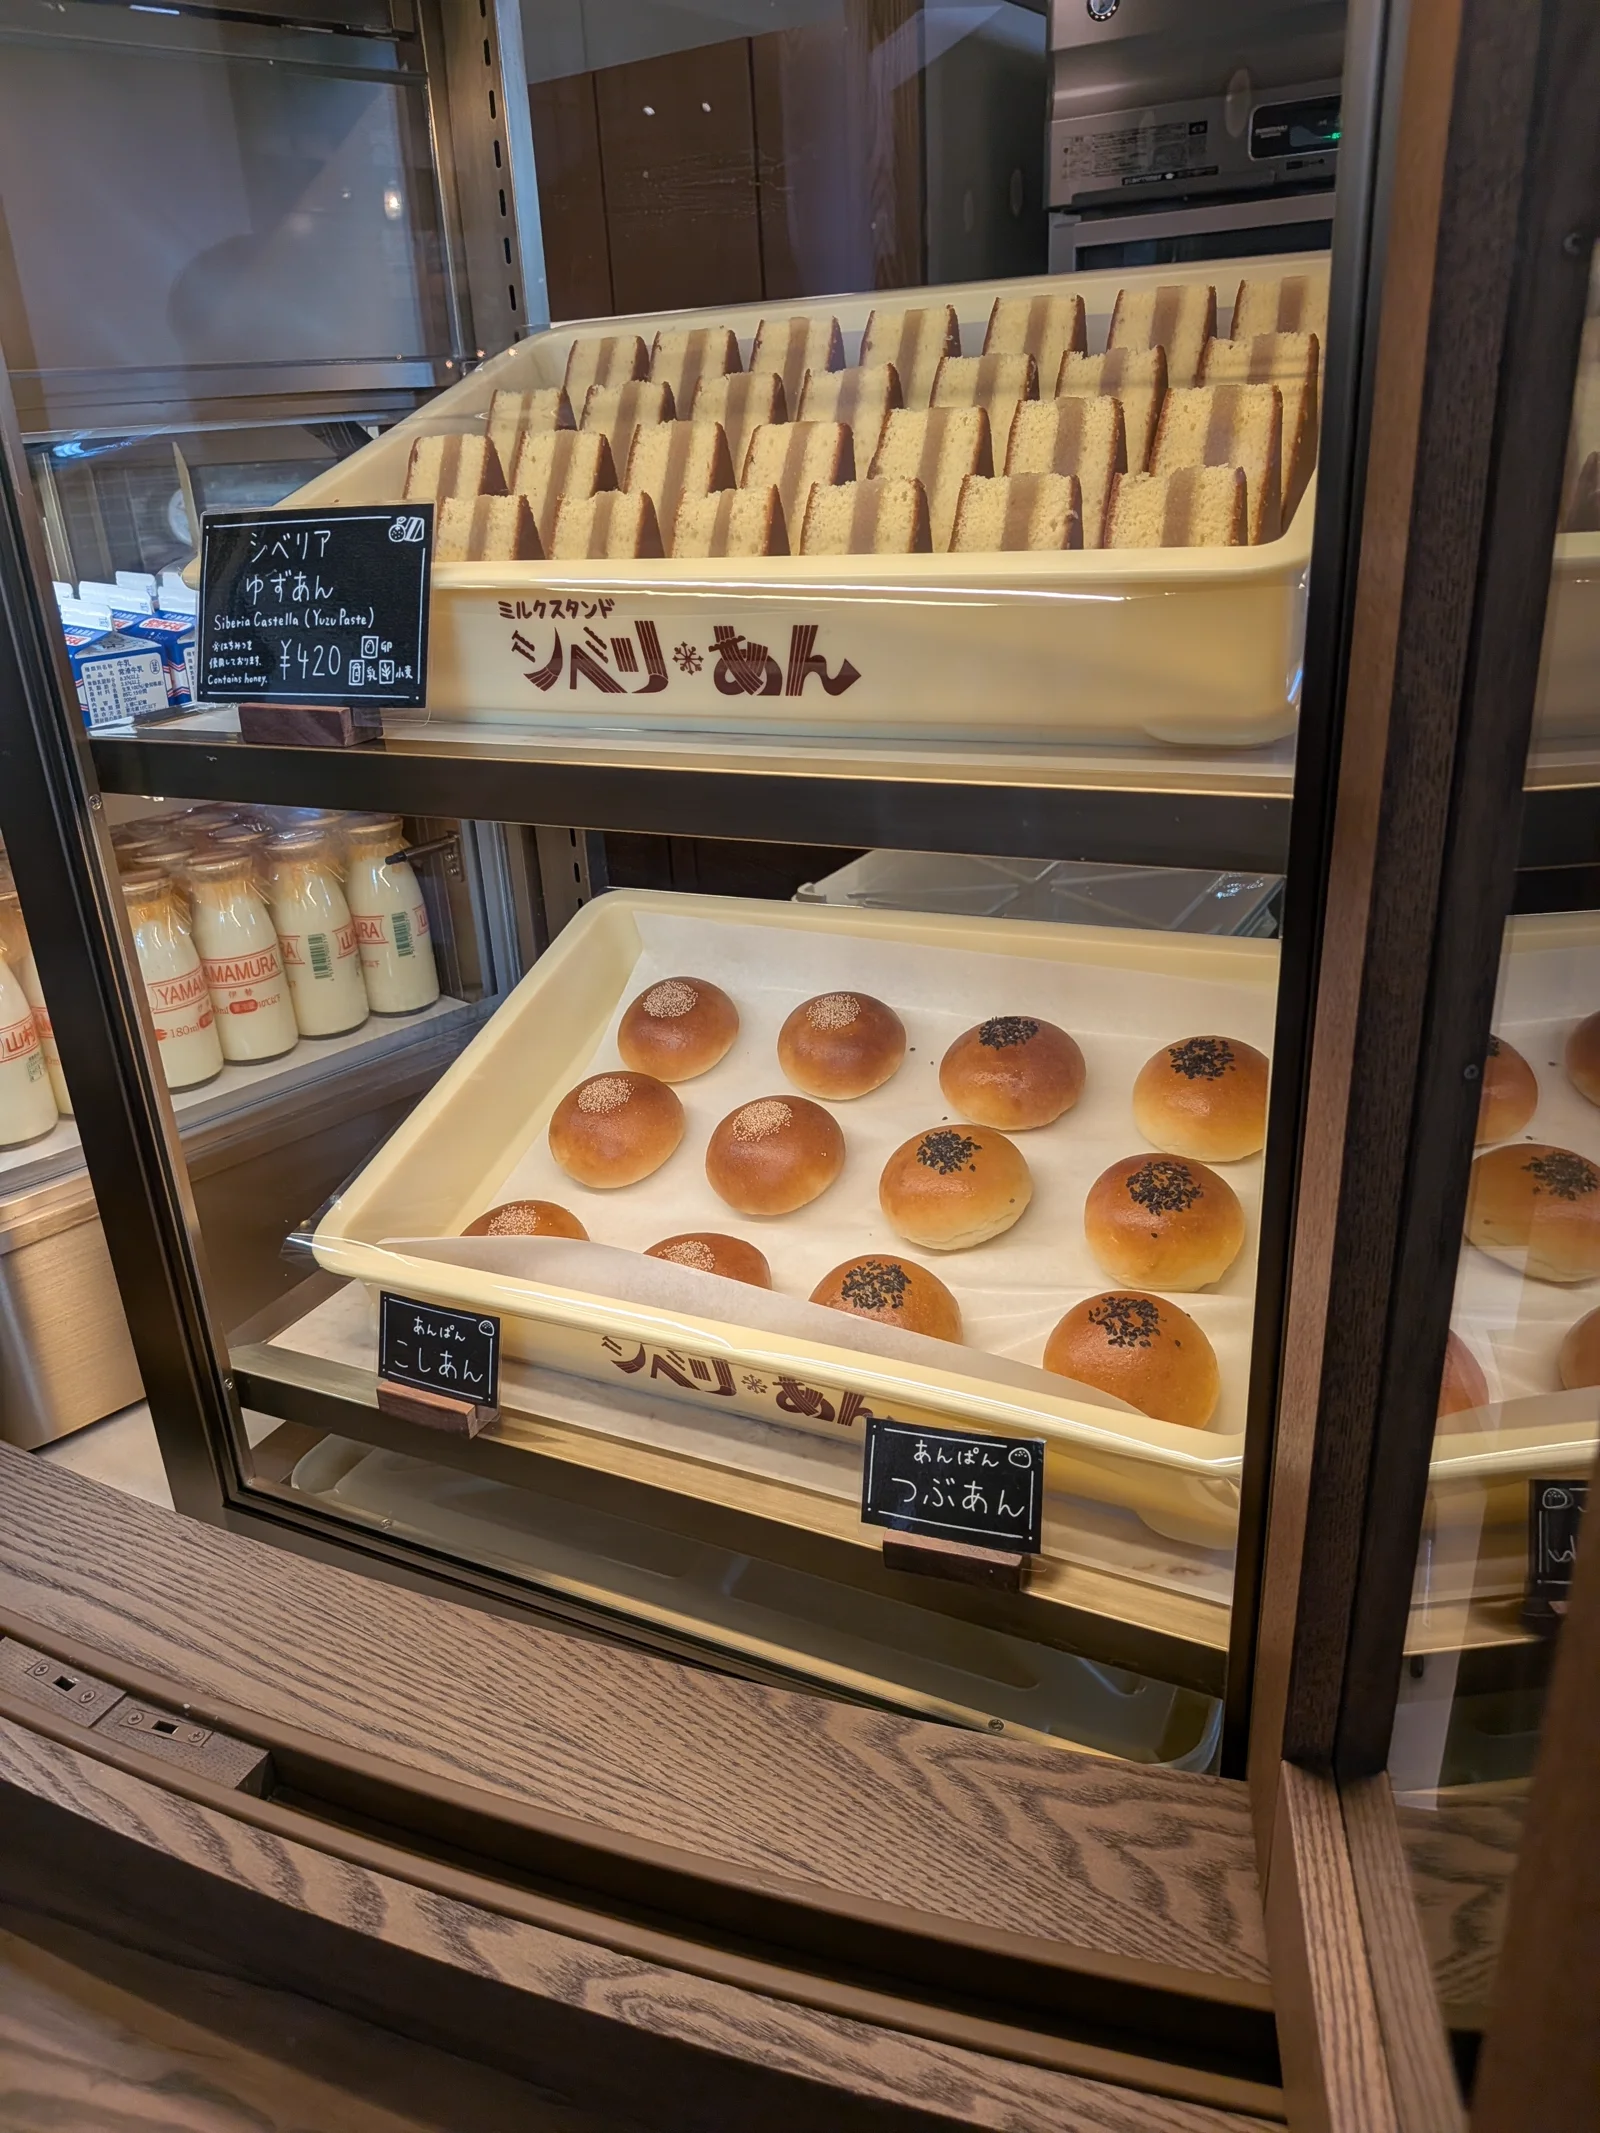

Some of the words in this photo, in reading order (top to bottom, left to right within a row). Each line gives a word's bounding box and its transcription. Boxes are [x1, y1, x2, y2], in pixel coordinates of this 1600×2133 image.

[250, 528, 331, 563] シベリア
[246, 569, 334, 605] ゆずあん
[214, 614, 250, 631] Siberia
[253, 611, 298, 627] Castella
[304, 608, 337, 628] (Yuzu
[339, 607, 374, 628] Paste)
[496, 598, 616, 620] ミルクスタンド
[280, 638, 341, 681] ¥420
[395, 665, 413, 679] 小麦
[207, 673, 242, 685] Contains
[244, 672, 268, 687] honey.
[366, 665, 378, 682] 乳
[170, 1022, 200, 1039] 180ml
[413, 1315, 466, 1342] あんぱん
[394, 1339, 484, 1383] こしあん
[913, 1439, 1000, 1468] あんぱん
[891, 1477, 1025, 1518] つぶあん
